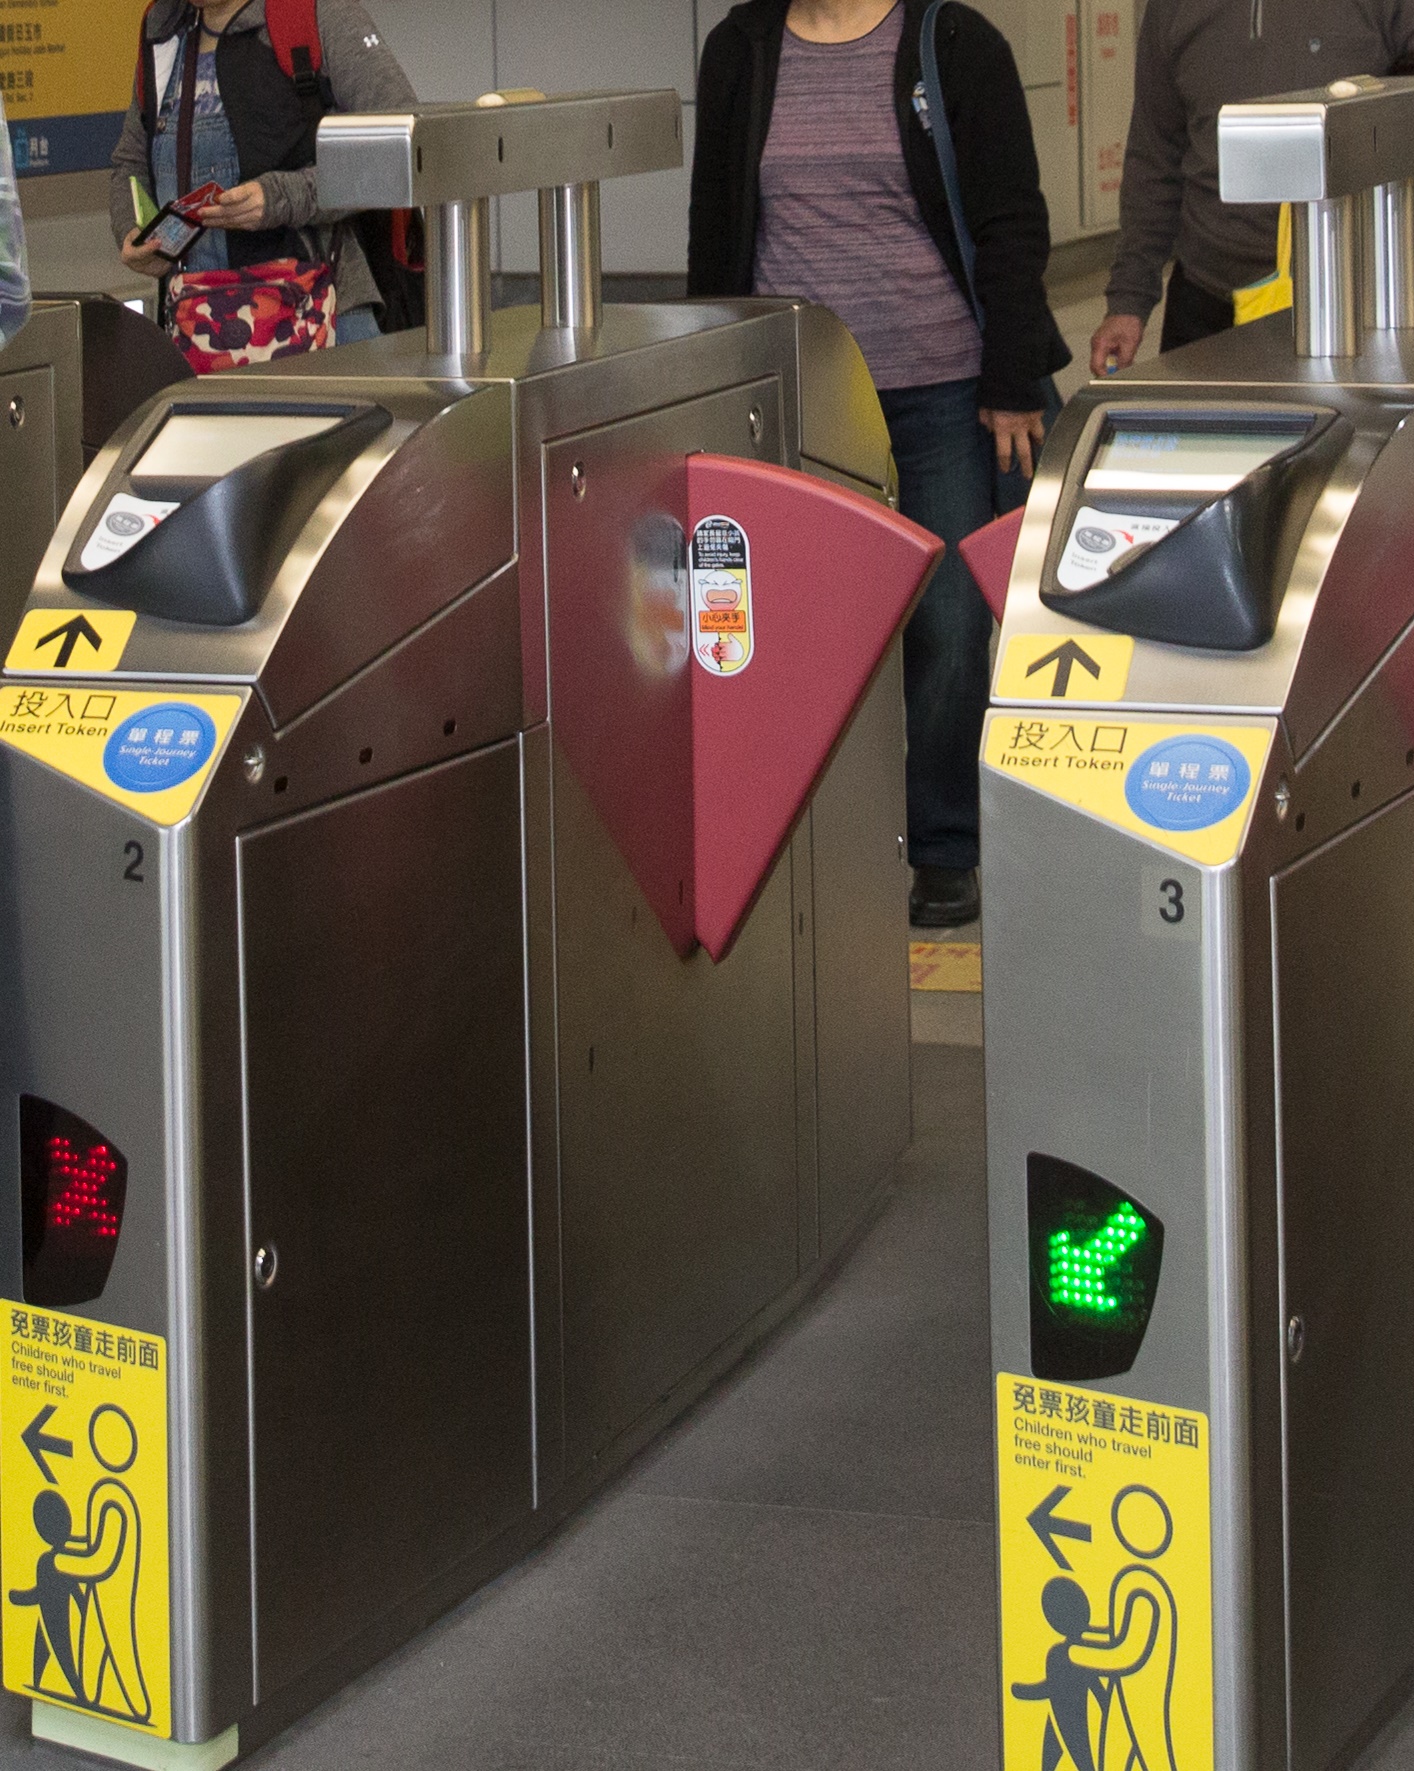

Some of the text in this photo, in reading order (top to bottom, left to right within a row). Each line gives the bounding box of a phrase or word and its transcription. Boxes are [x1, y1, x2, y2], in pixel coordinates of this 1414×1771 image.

[9, 691, 117, 721] 投入口
[0, 720, 108, 737] Insert Token
[127, 727, 200, 746] 單程票
[1009, 721, 1128, 754] 投入口
[138, 756, 170, 766] Ticket
[1000, 753, 1125, 771] Insert Token
[1149, 761, 1230, 781] 單程票
[1166, 792, 1202, 803] Ticket
[123, 840, 144, 882] 2
[1159, 878, 1185, 923] 3
[11, 1308, 159, 1371] 免票孩童走前面
[12, 1341, 122, 1379] Children who travel
[12, 1357, 74, 1384] free should
[12, 1375, 69, 1398] enter first.
[1012, 1382, 1199, 1449] 免票孩童走前面
[1014, 1417, 1152, 1459] Children who travel
[1014, 1435, 1093, 1463] free should
[1015, 1453, 1086, 1479] enter first.
